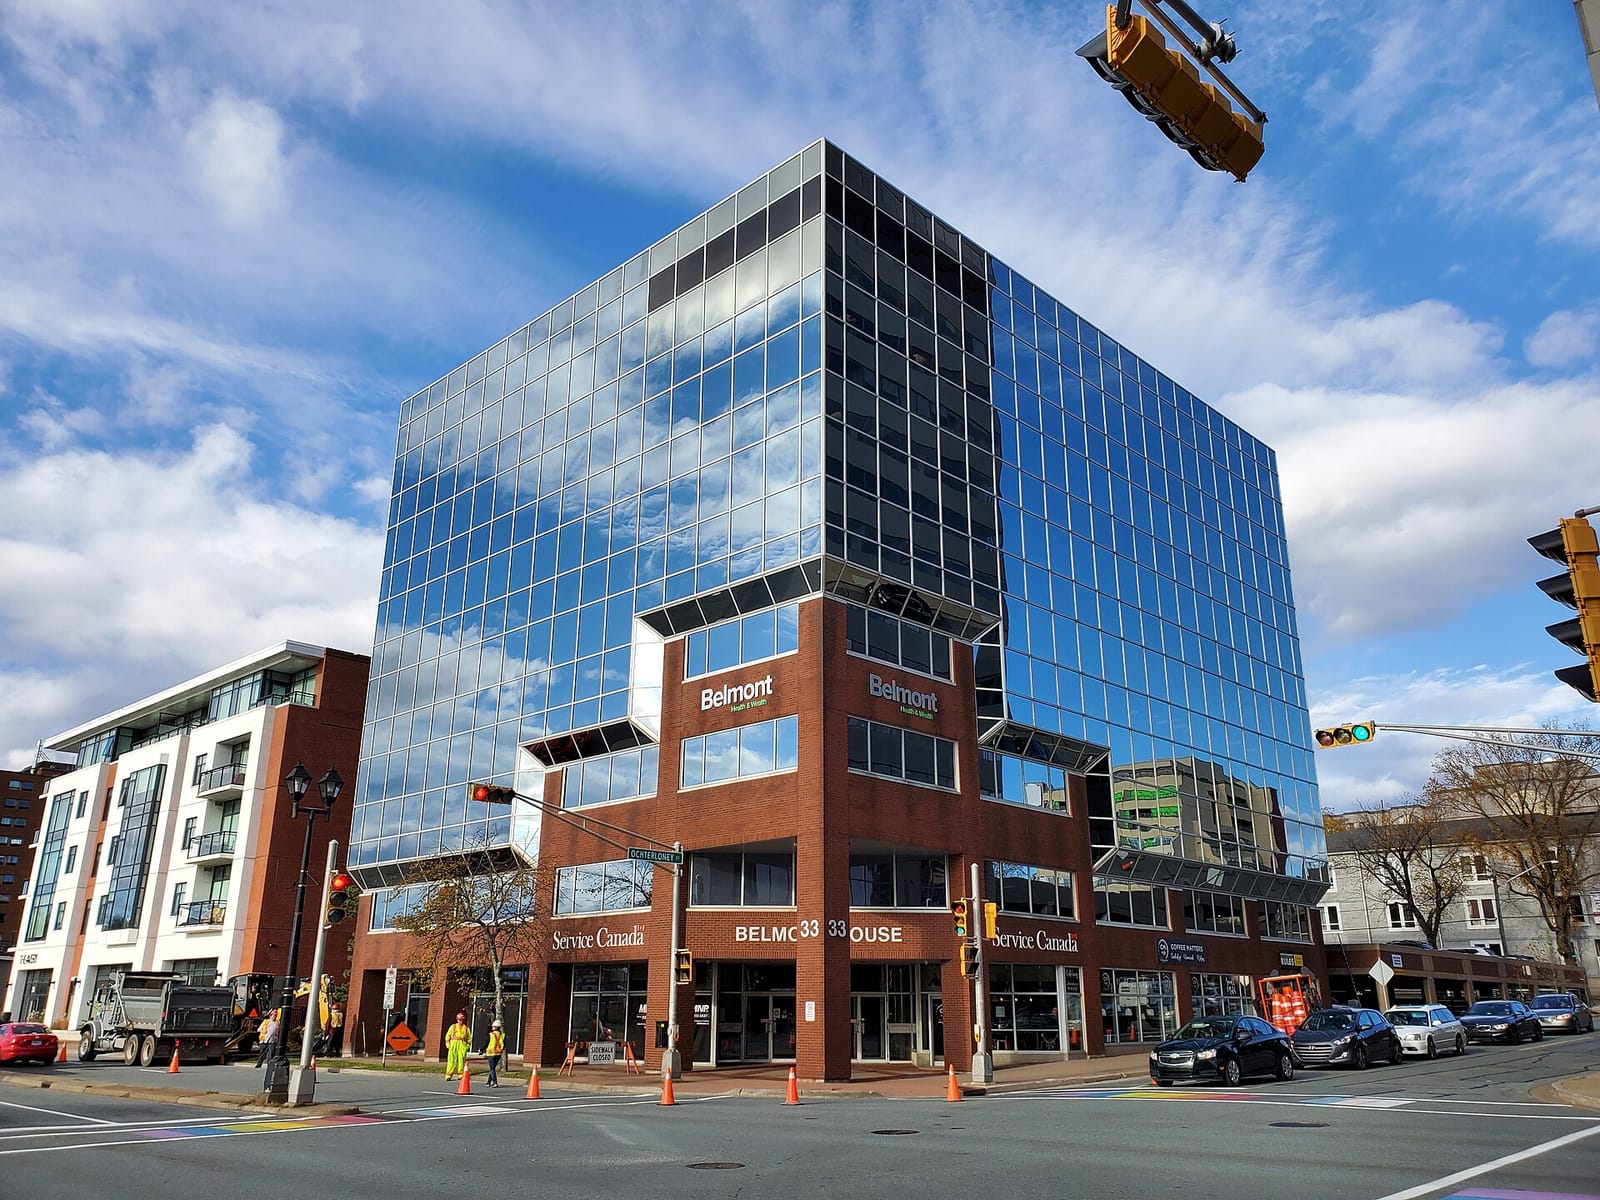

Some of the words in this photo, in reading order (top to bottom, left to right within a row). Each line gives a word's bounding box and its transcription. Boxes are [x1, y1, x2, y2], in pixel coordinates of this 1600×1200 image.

[701, 674, 773, 711] Belmont
[869, 673, 938, 713] Belmont
[730, 702, 746, 712] Health
[900, 705, 915, 715] Health
[630, 849, 675, 861] OCHTERLONEY
[552, 930, 594, 950] Service
[596, 924, 645, 948] Canada
[735, 926, 797, 942] BELMO
[850, 926, 903, 943] OUSE
[800, 919, 820, 938] 33
[828, 919, 847, 938] 33
[992, 927, 1035, 949] Service
[1036, 930, 1079, 953] Canada
[1170, 943, 1186, 951] COFFEE
[1186, 944, 1204, 953] MATTERS
[592, 1054, 612, 1062] CLOSED
